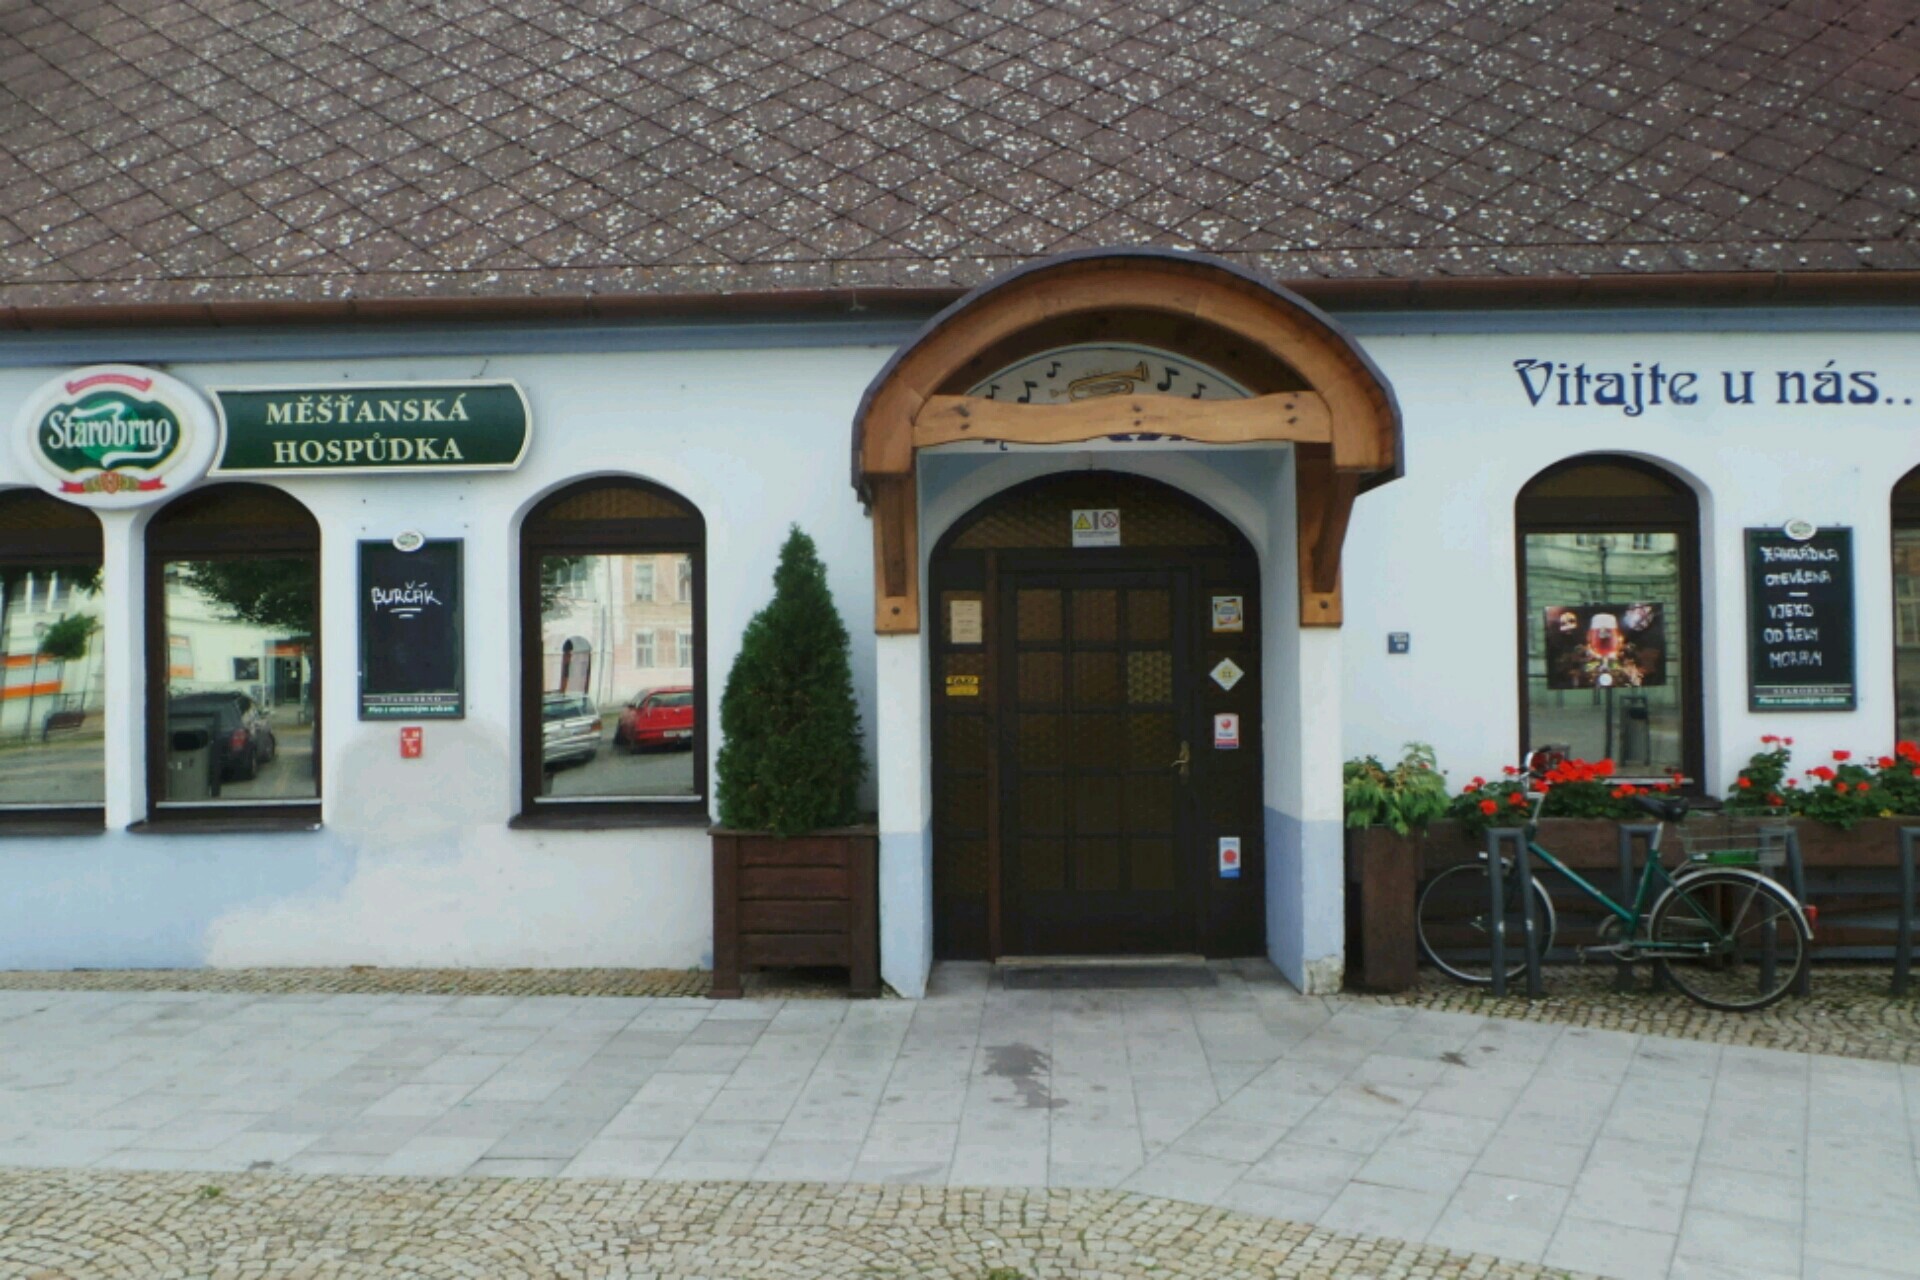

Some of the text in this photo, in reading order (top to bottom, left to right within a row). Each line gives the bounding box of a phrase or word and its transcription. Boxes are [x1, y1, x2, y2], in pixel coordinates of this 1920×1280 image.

[1513, 359, 1698, 417] Vitajte
[1721, 371, 1755, 404] u
[266, 393, 470, 425] MĚŠŤANSKÁ
[48, 402, 172, 467] Starobrno
[273, 432, 464, 463] HOSPŮDKA
[371, 581, 442, 611] BURČÁK
